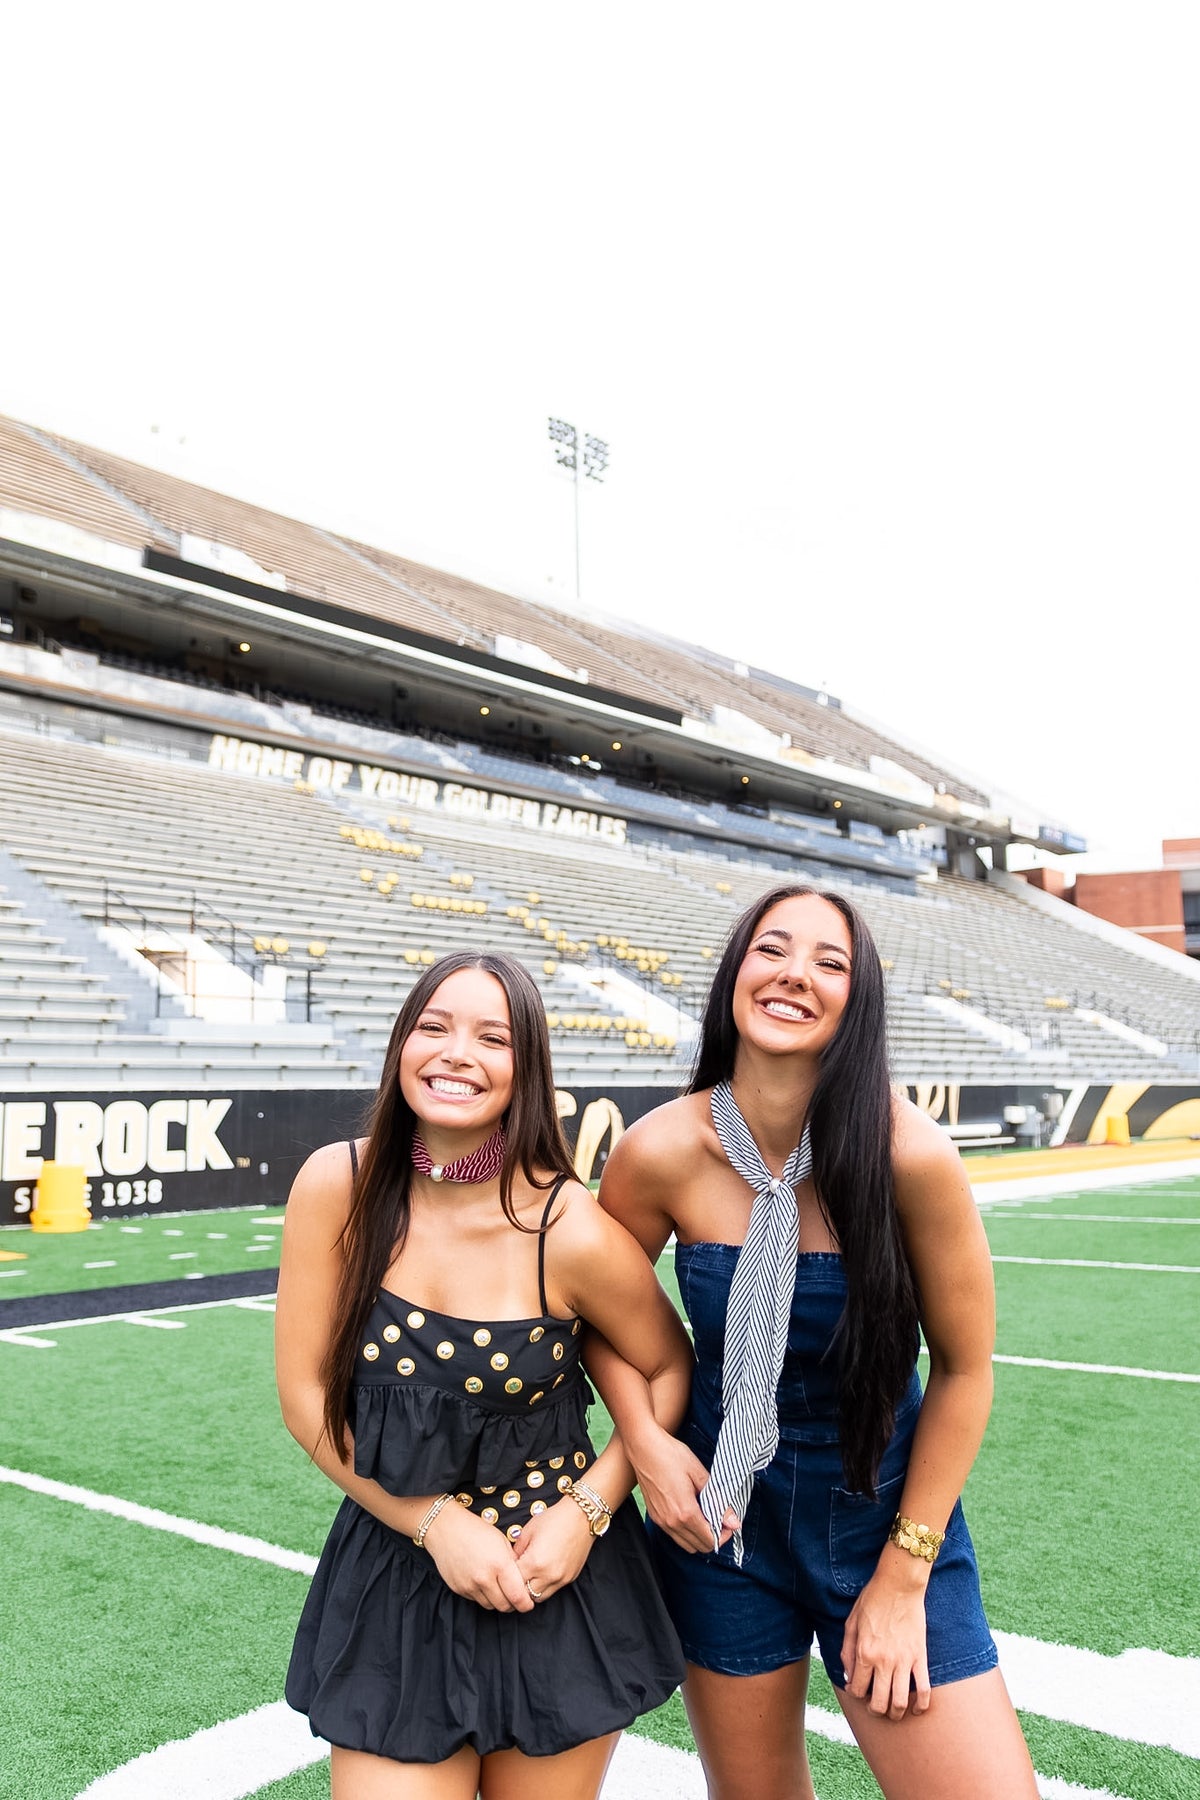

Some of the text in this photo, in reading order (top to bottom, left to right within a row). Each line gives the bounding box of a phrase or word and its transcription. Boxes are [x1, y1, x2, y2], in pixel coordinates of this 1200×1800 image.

[208, 734, 627, 845] HOME OF YOUR GOLDEN EAGLES
[0, 1101, 46, 1181] E
[53, 1098, 235, 1177] ROCK
[101, 1178, 163, 1208] 1938
